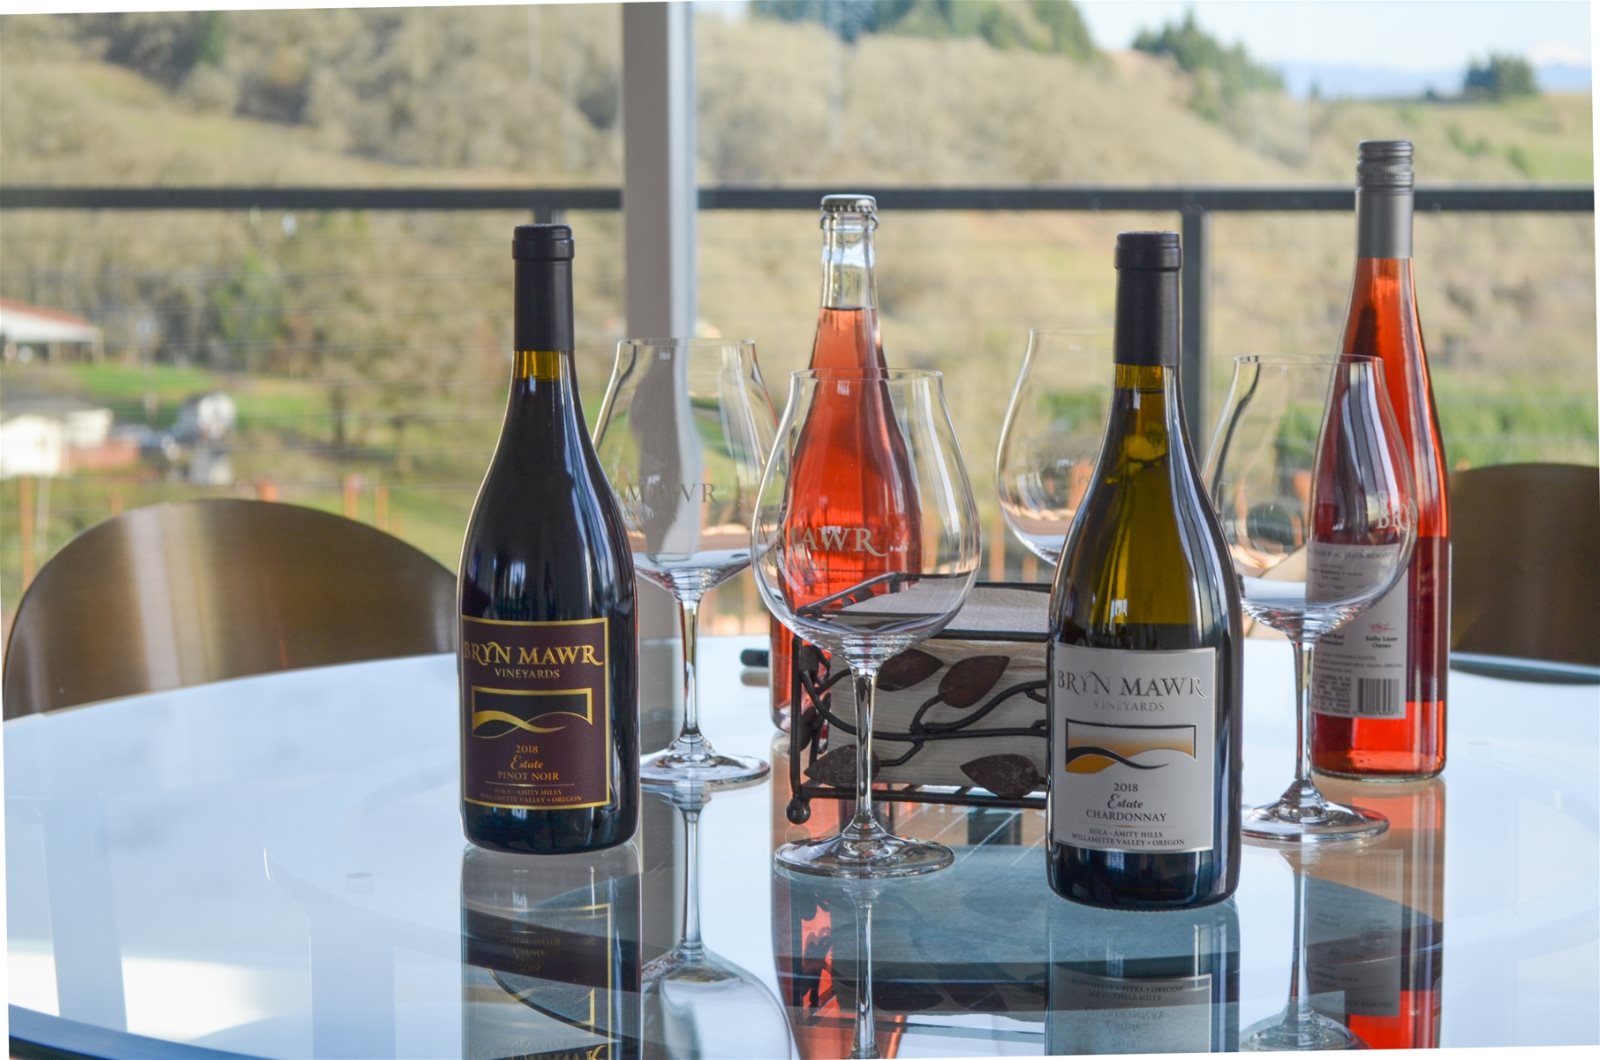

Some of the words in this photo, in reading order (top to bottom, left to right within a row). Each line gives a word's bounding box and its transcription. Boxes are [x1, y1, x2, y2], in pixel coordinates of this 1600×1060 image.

[464, 641, 511, 666] BRYN
[518, 645, 604, 666] MAWR
[494, 668, 560, 679] VINEYARDS
[1057, 670, 1111, 696] BRYN
[1120, 676, 1207, 698] MAWR
[1093, 701, 1165, 712] VINEYARDS
[515, 744, 539, 753] 2018
[510, 755, 544, 770] Estate
[497, 771, 529, 780] PINOT
[531, 771, 560, 781] NOIR
[1113, 782, 1139, 792] 2018
[1107, 793, 1144, 809] Estate
[1086, 809, 1167, 822] CHARDONNAY
[1089, 828, 1108, 836] EOLA
[1113, 830, 1140, 838] AMITY
[1140, 830, 1163, 838] HILLS
[1071, 832, 1115, 845] WILLAMETTE
[1115, 838, 1146, 847] VALLEY
[1152, 838, 1185, 847] OREGON
